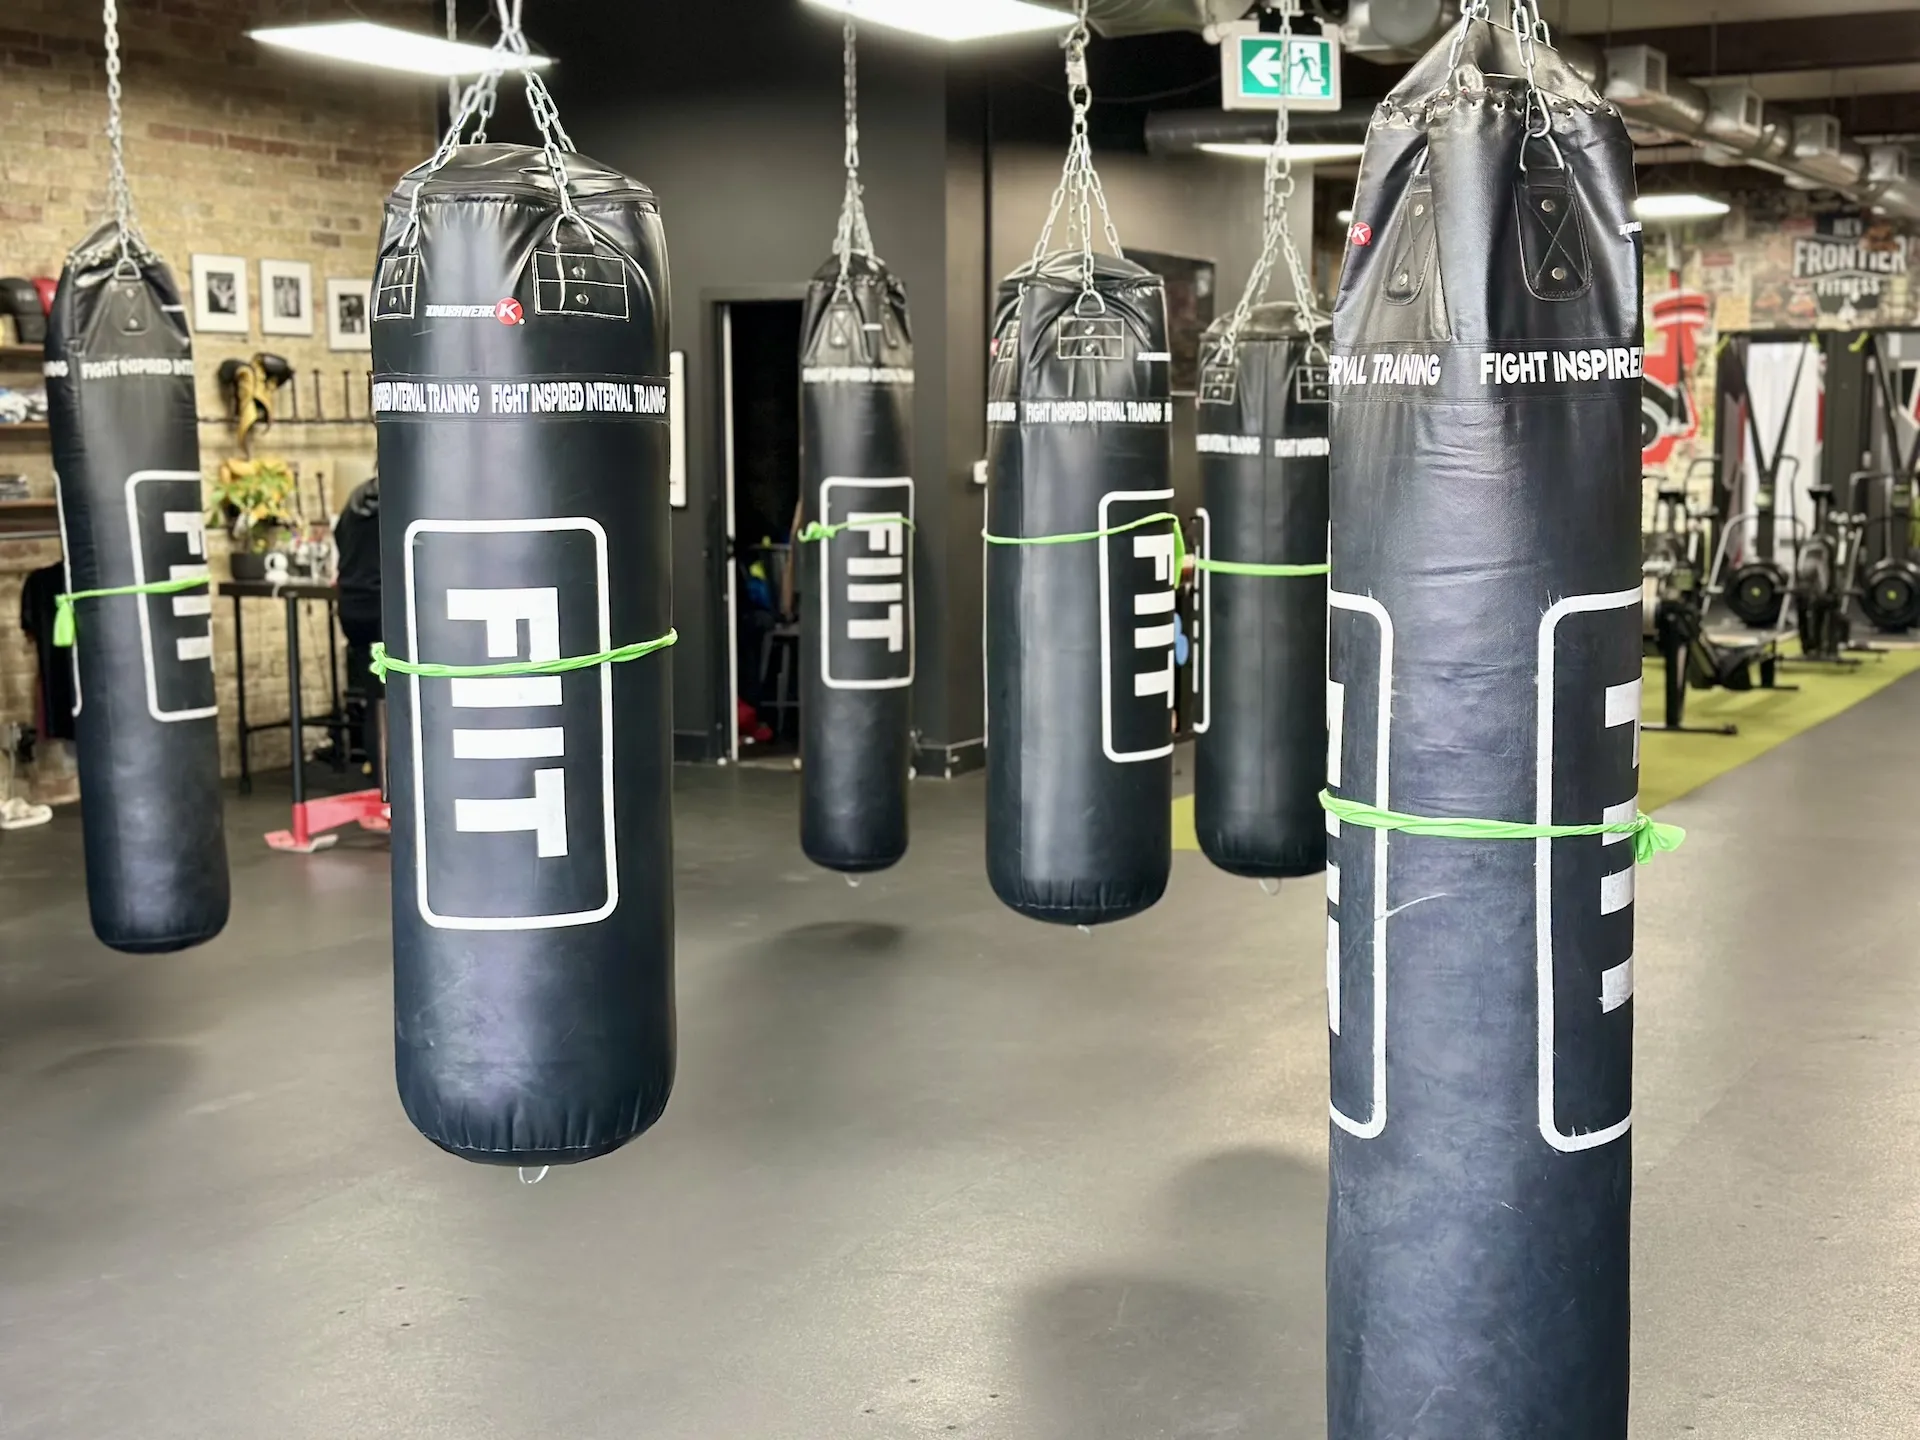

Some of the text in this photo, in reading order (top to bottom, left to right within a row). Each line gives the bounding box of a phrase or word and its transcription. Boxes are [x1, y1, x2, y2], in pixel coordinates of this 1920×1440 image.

[1328, 353, 1441, 386] RVAL TRAINING
[1480, 351, 1548, 385] FIGHT
[427, 383, 480, 413] TRAINING
[491, 383, 530, 413] FIGHT
[531, 381, 585, 413] INSPIRED
[585, 382, 633, 413] INTERVAL
[446, 586, 569, 858] FIIT
